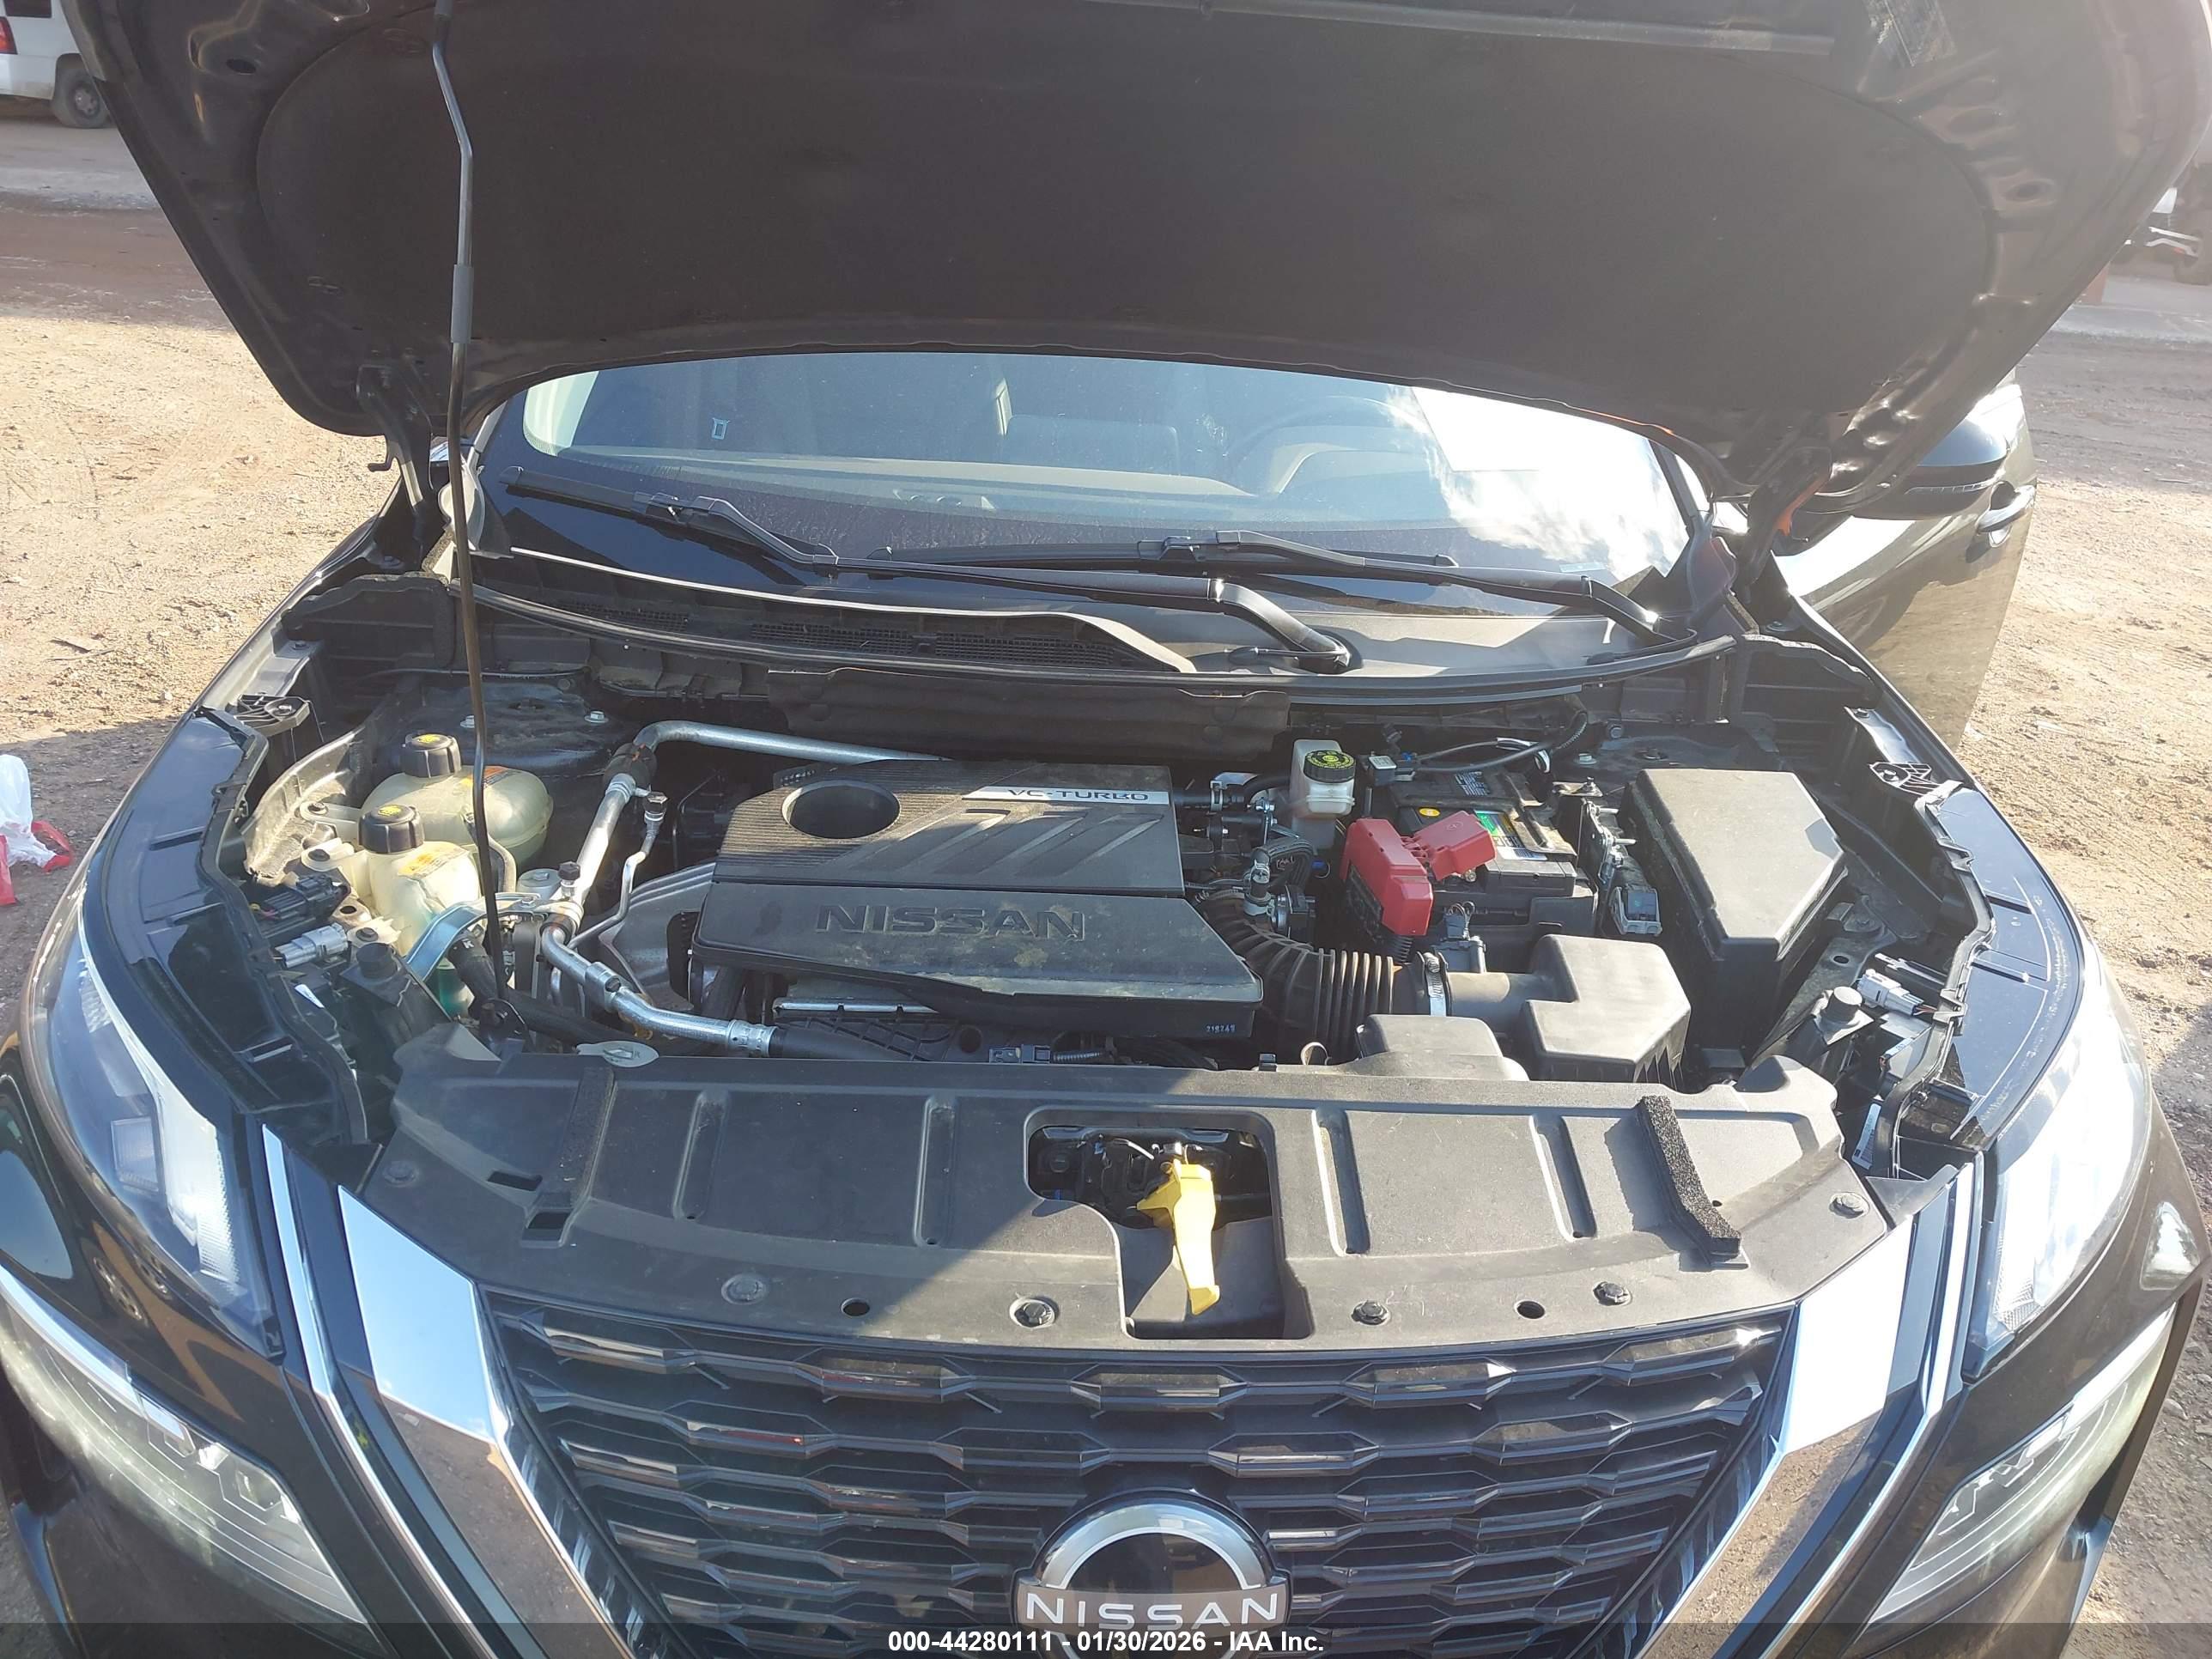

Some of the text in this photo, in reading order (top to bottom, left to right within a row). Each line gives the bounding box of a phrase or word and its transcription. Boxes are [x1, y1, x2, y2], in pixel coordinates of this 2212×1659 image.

[1008, 789, 1149, 801] VC-TURBO
[817, 904, 1085, 942] NISSAN
[1026, 1593, 1279, 1631] NISSAN
